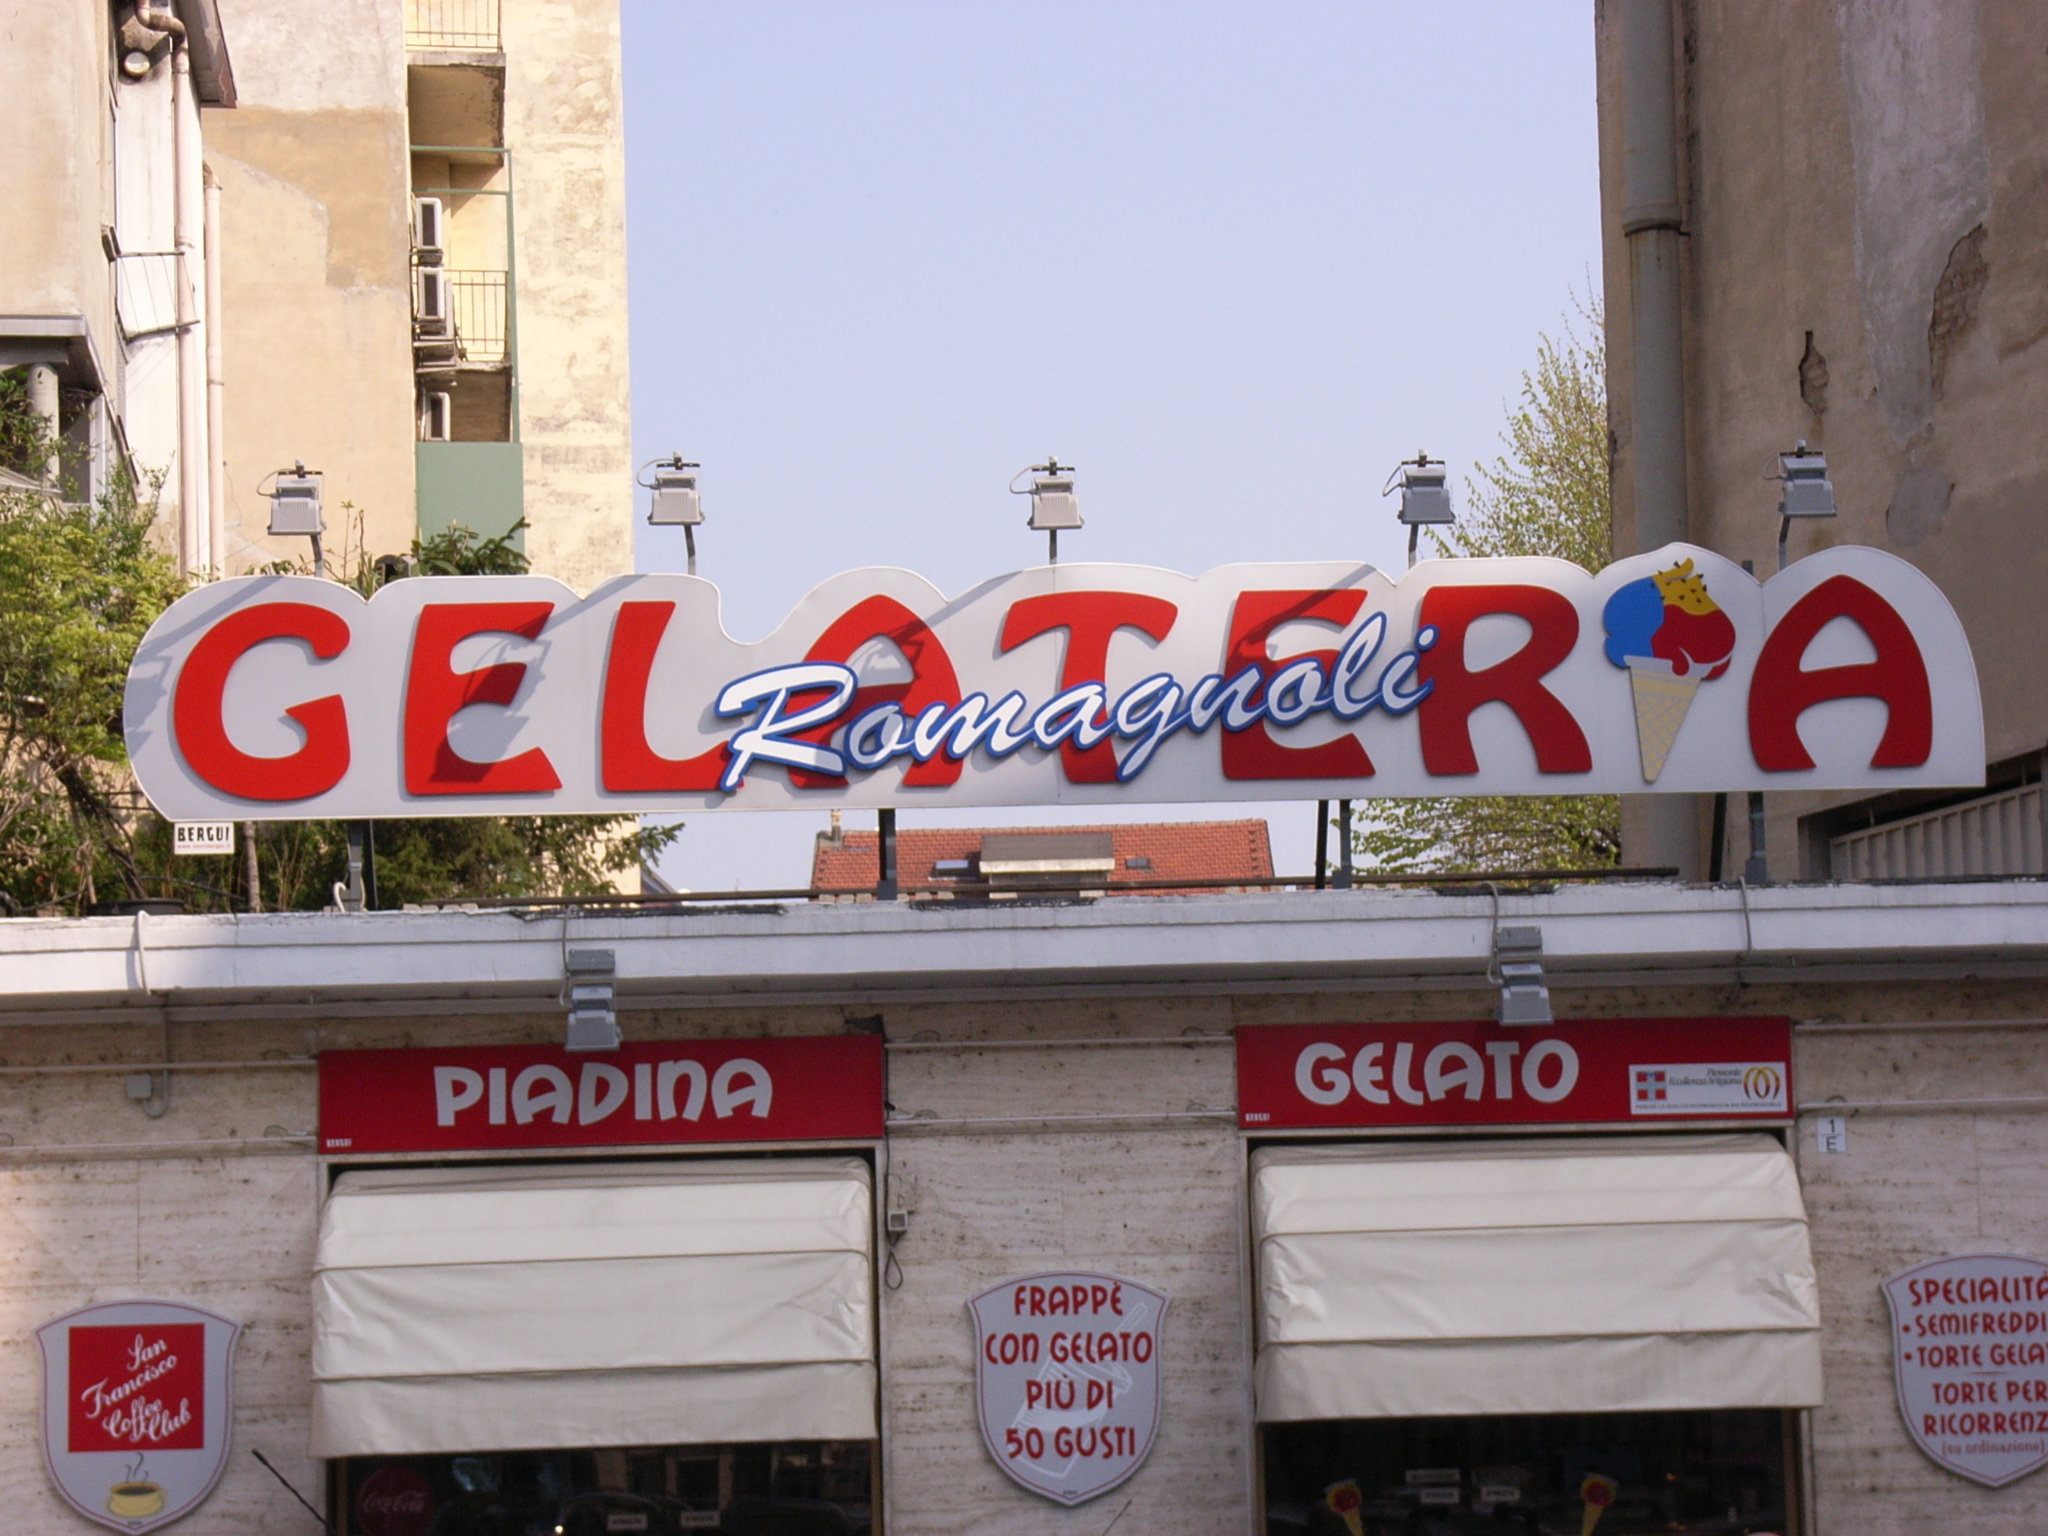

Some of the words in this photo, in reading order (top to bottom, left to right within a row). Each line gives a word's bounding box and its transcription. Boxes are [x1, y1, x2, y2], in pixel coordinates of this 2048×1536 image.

[713, 612, 1438, 792] Romagnoli
[178, 826, 230, 842] BERGUI
[1295, 1038, 1579, 1106] GELATO
[433, 1058, 773, 1128] PIADINA
[1828, 1118, 1835, 1133] 1
[1826, 1136, 1837, 1151] E
[1014, 1281, 1123, 1316] FRAPPÈ
[1915, 1311, 2047, 1337] SEMIFREDDI
[127, 1333, 167, 1370] San
[985, 1332, 1039, 1365] CON
[1050, 1331, 1153, 1363] GELATO
[1917, 1344, 1982, 1368] TORTE
[81, 1355, 177, 1418] Francisco
[1026, 1373, 1075, 1410] PIÙ
[1086, 1380, 1113, 1410] DI
[1932, 1381, 1998, 1404] TORTE
[2006, 1379, 2048, 1402] PER
[102, 1395, 162, 1442] Coffee
[147, 1397, 192, 1441] Club
[1006, 1427, 1044, 1459] 50
[1054, 1426, 1135, 1459] GUSTI
